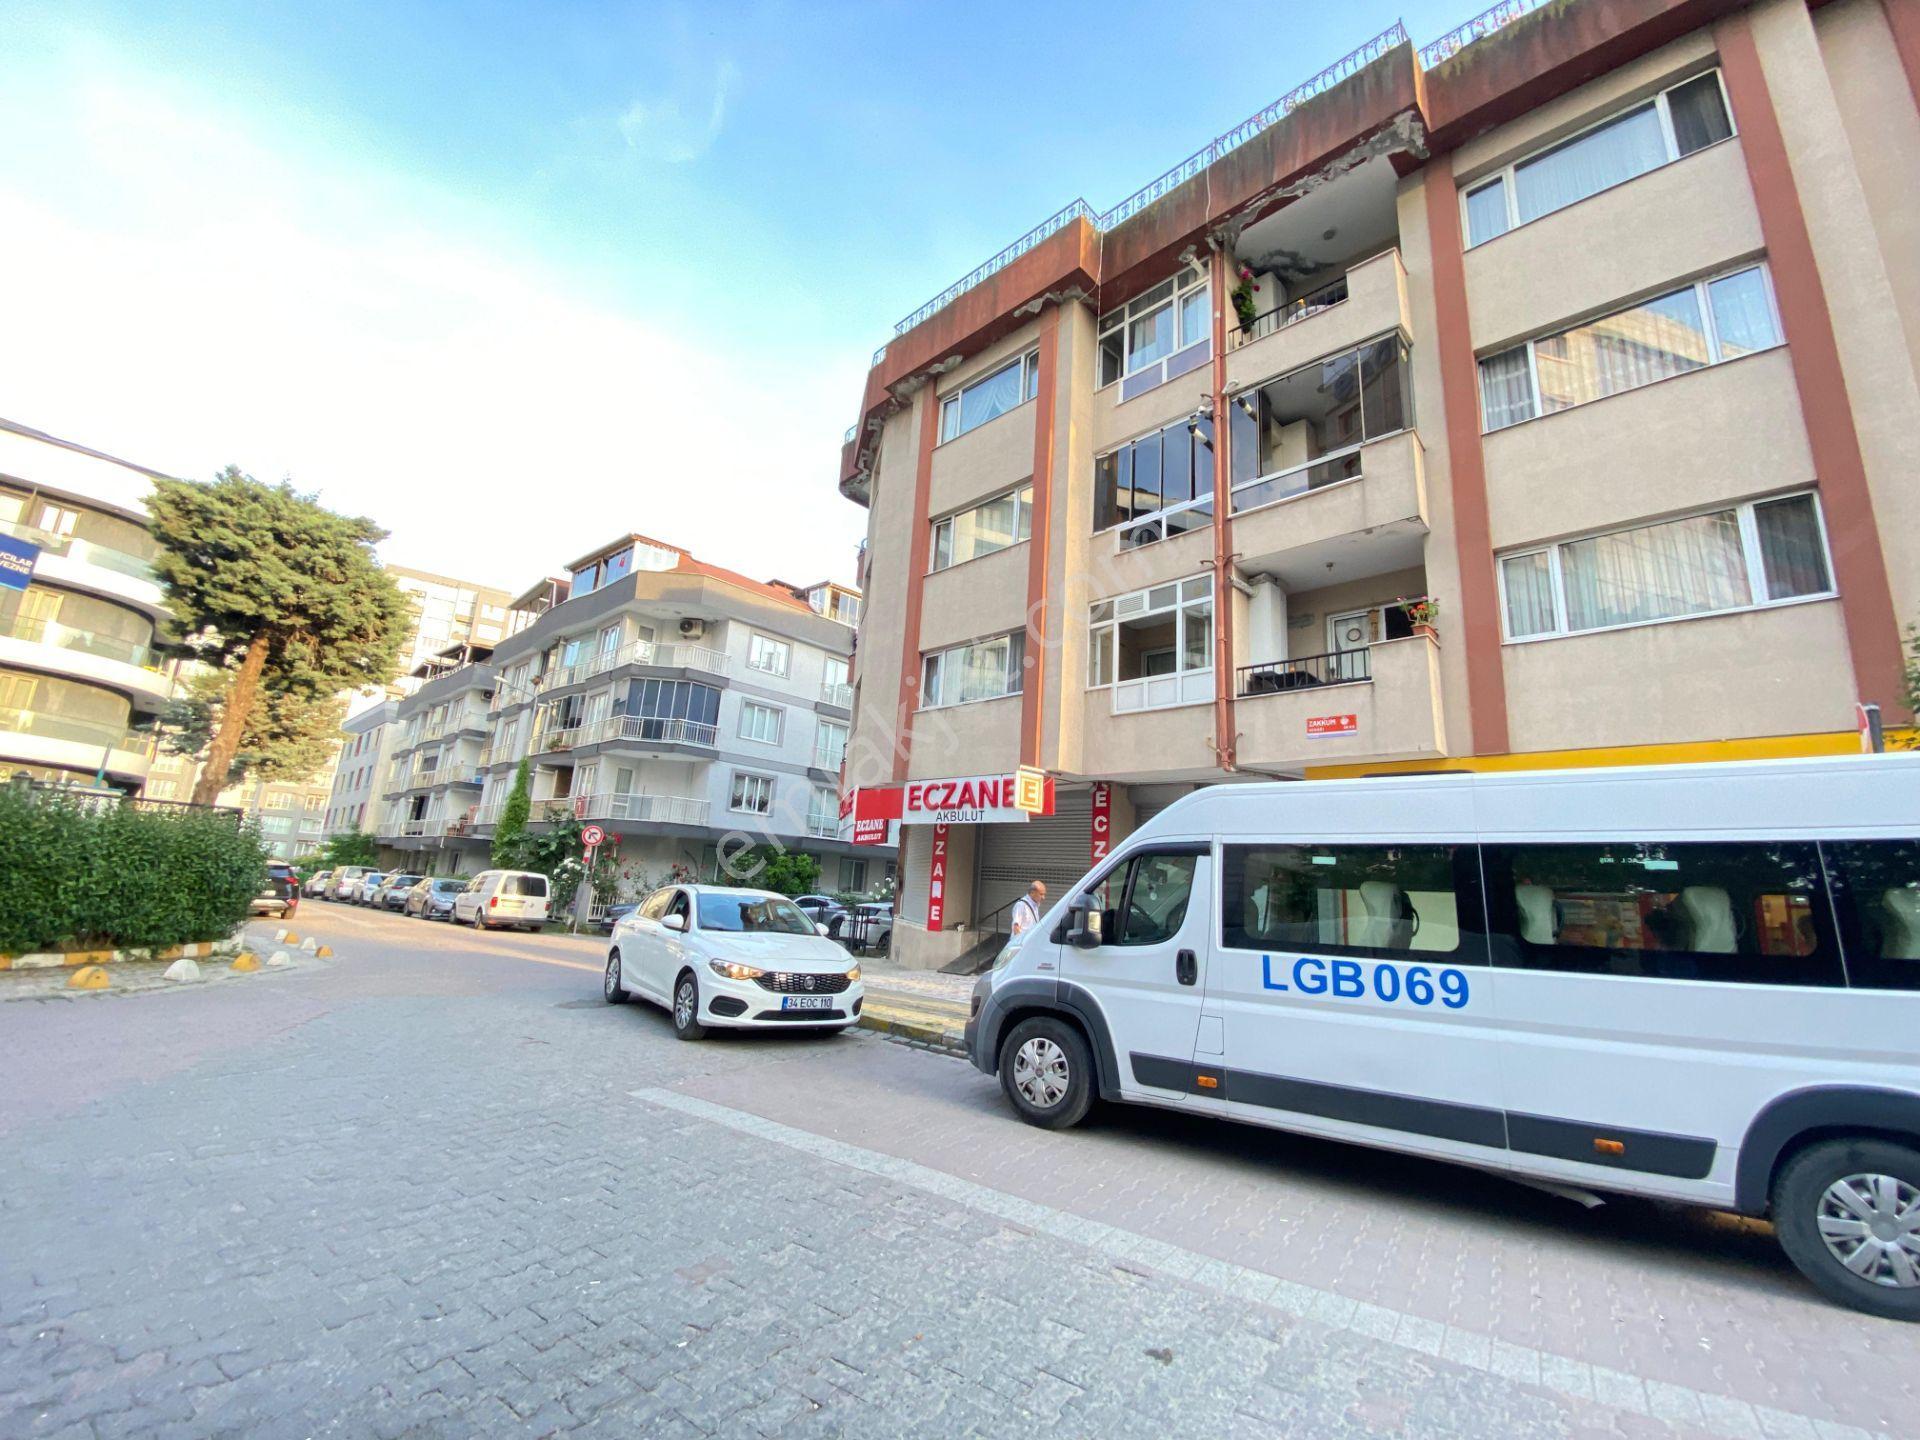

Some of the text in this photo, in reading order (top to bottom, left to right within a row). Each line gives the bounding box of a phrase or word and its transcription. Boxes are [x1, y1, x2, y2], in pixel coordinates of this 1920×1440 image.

[1308, 719, 1336, 727] ZAKKUM
[907, 778, 1015, 811] ECZANE
[1024, 785, 1037, 803] E
[936, 810, 985, 822] AKBULUT
[856, 819, 884, 832] ECZANE
[788, 998, 798, 1008] 34
[820, 998, 831, 1008] 110
